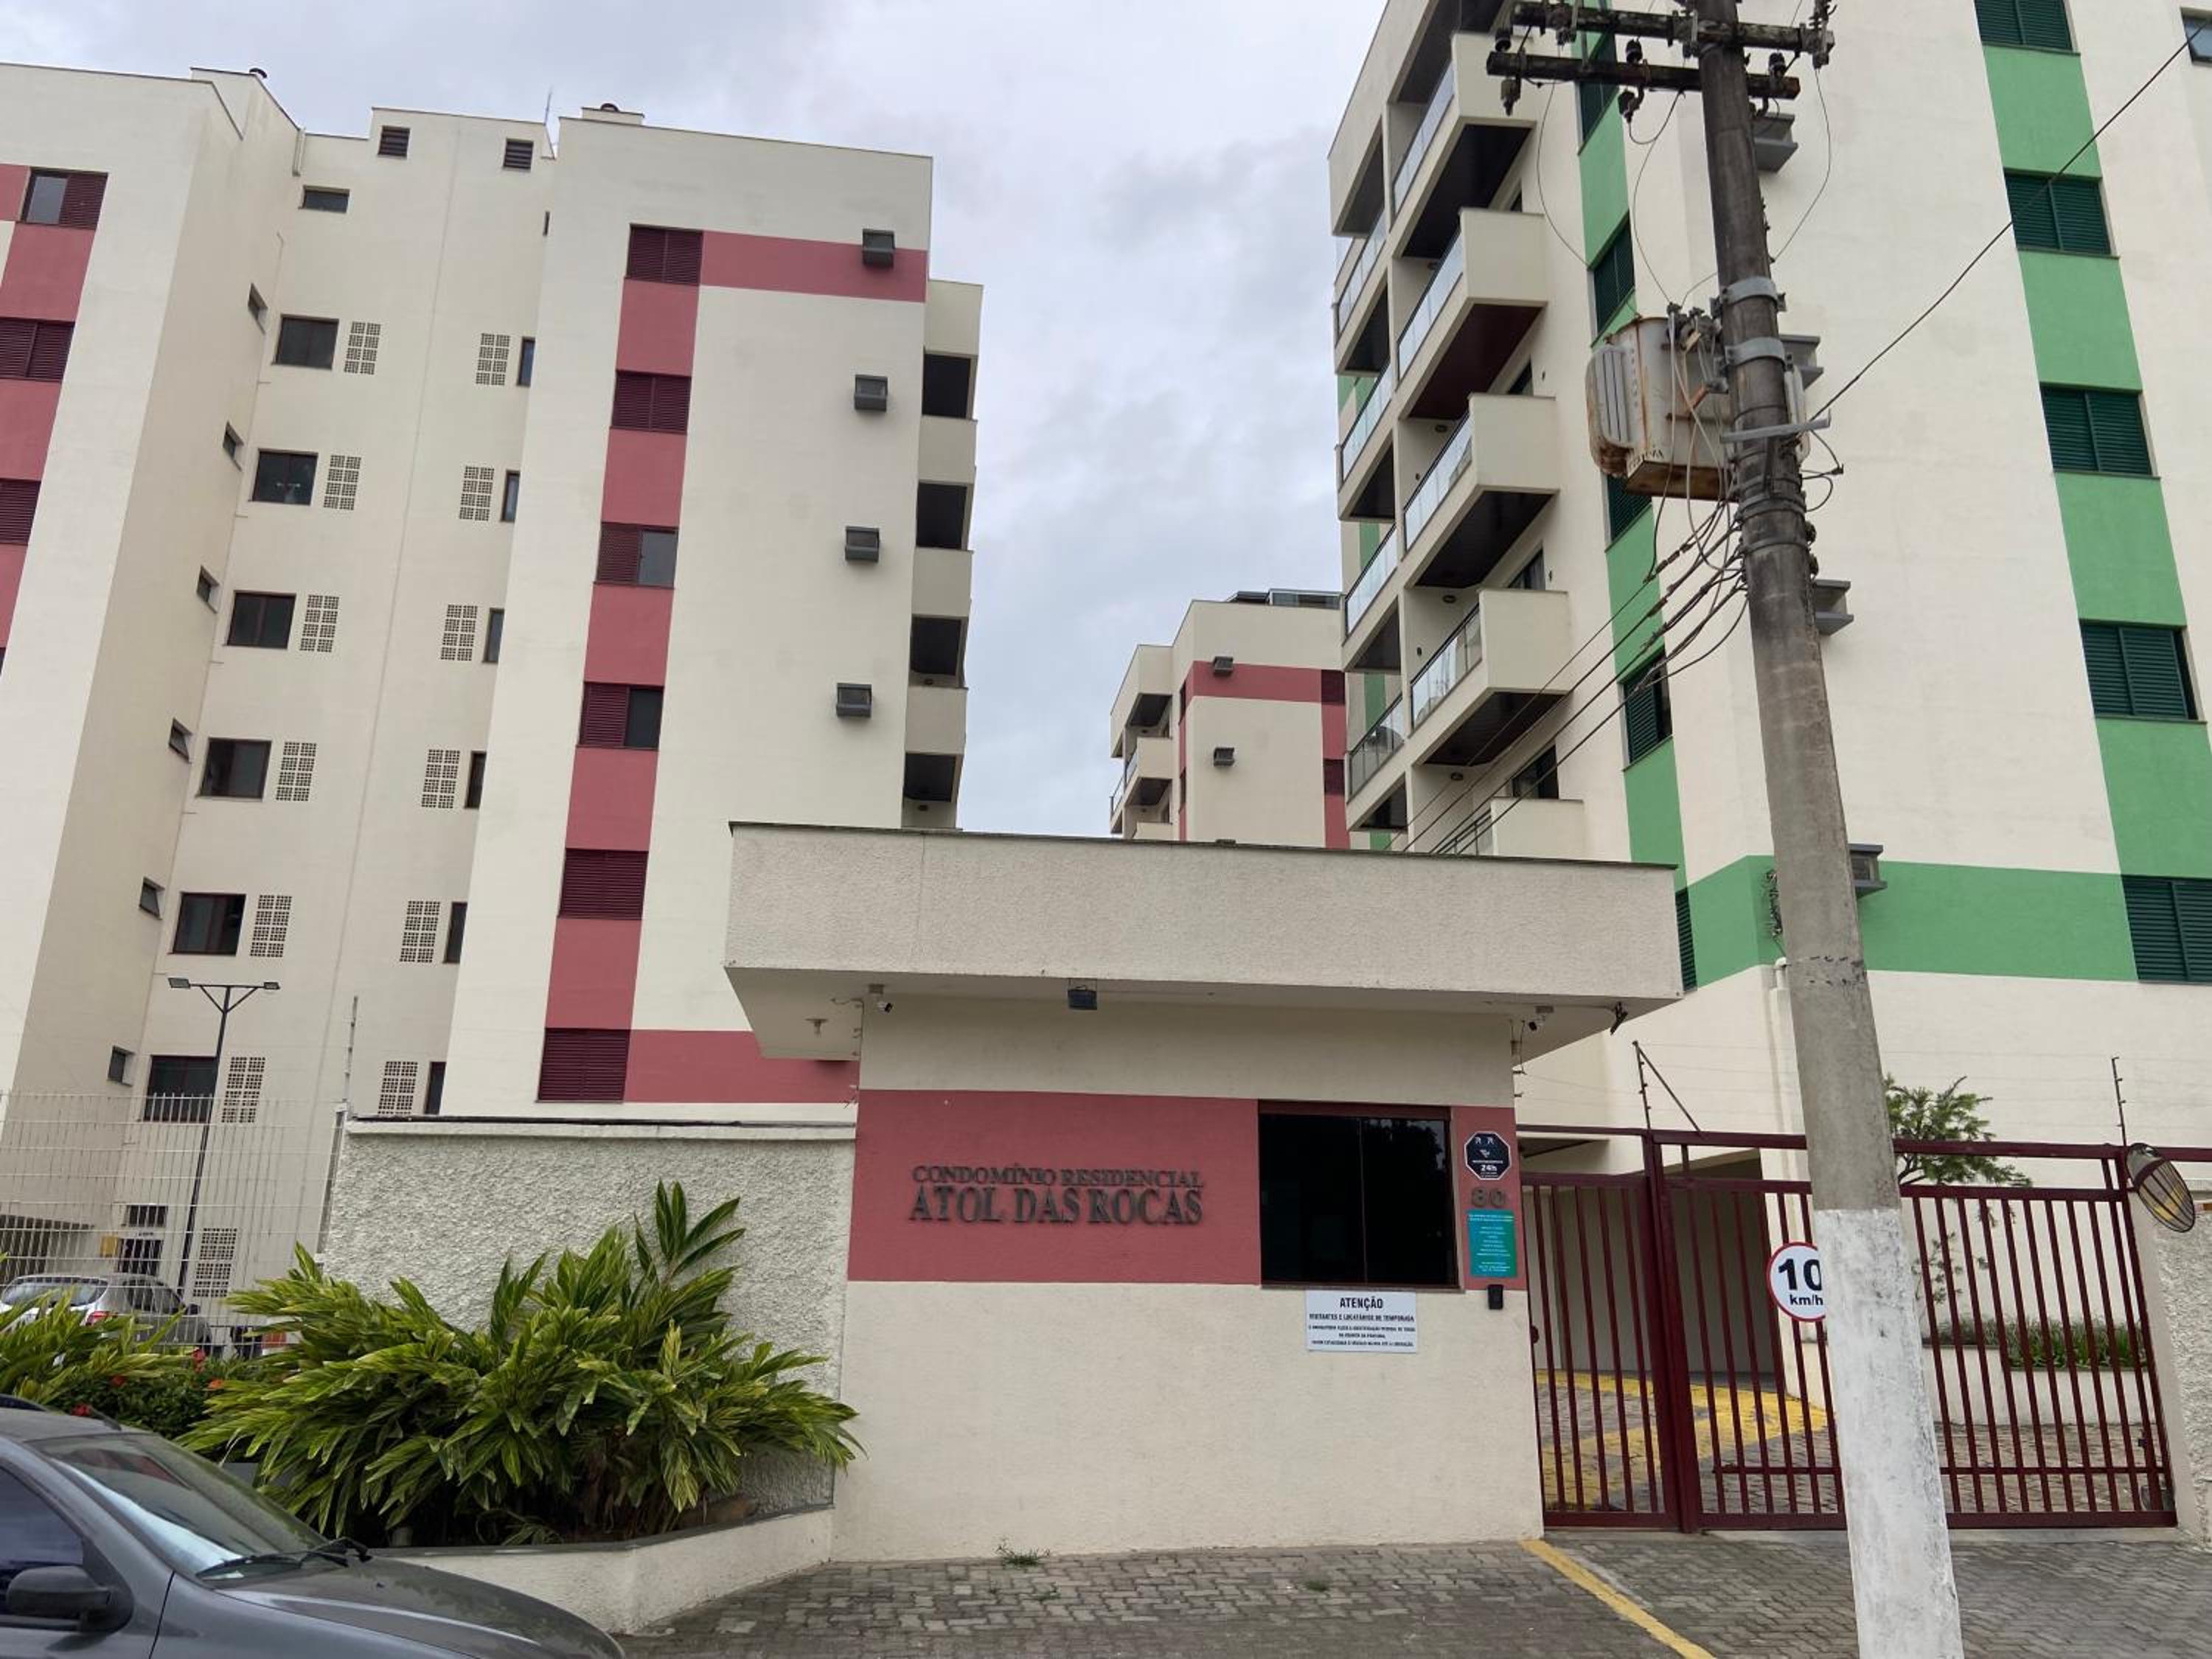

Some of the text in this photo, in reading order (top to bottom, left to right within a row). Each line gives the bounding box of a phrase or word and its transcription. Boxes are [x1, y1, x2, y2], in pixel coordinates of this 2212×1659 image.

[911, 1164, 1205, 1189] CONDOMÍNIO RESIDENCIAL
[909, 1186, 1203, 1225] ATOL DAS ROCAS
[1472, 1187, 1506, 1207] 80
[1778, 1259, 1822, 1291] 10
[1340, 1295, 1383, 1311] ATENÇÃO
[1790, 1294, 1823, 1305] km/h
